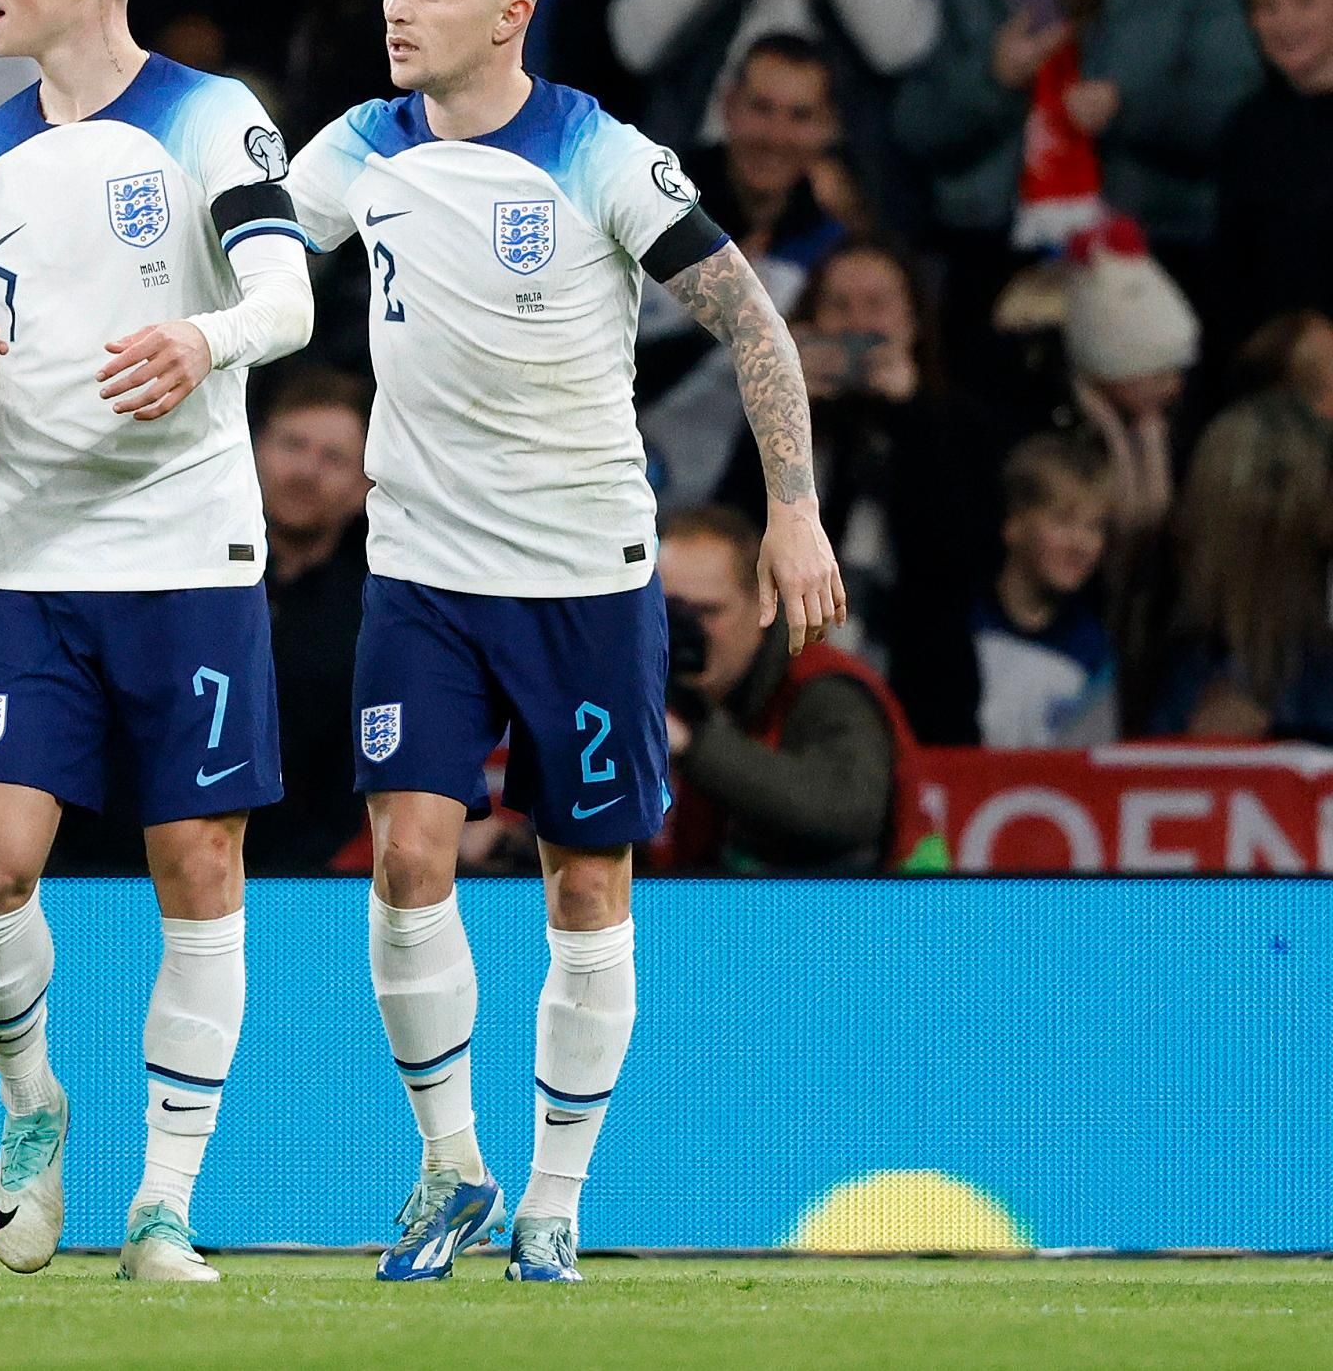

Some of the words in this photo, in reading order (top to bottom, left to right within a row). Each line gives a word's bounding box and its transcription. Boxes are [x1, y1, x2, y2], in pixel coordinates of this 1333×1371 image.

[140, 260, 167, 276] MALTA
[373, 240, 406, 323] 2
[515, 292, 542, 304] MALTA
[192, 665, 229, 749] 7
[575, 700, 616, 783] 2
